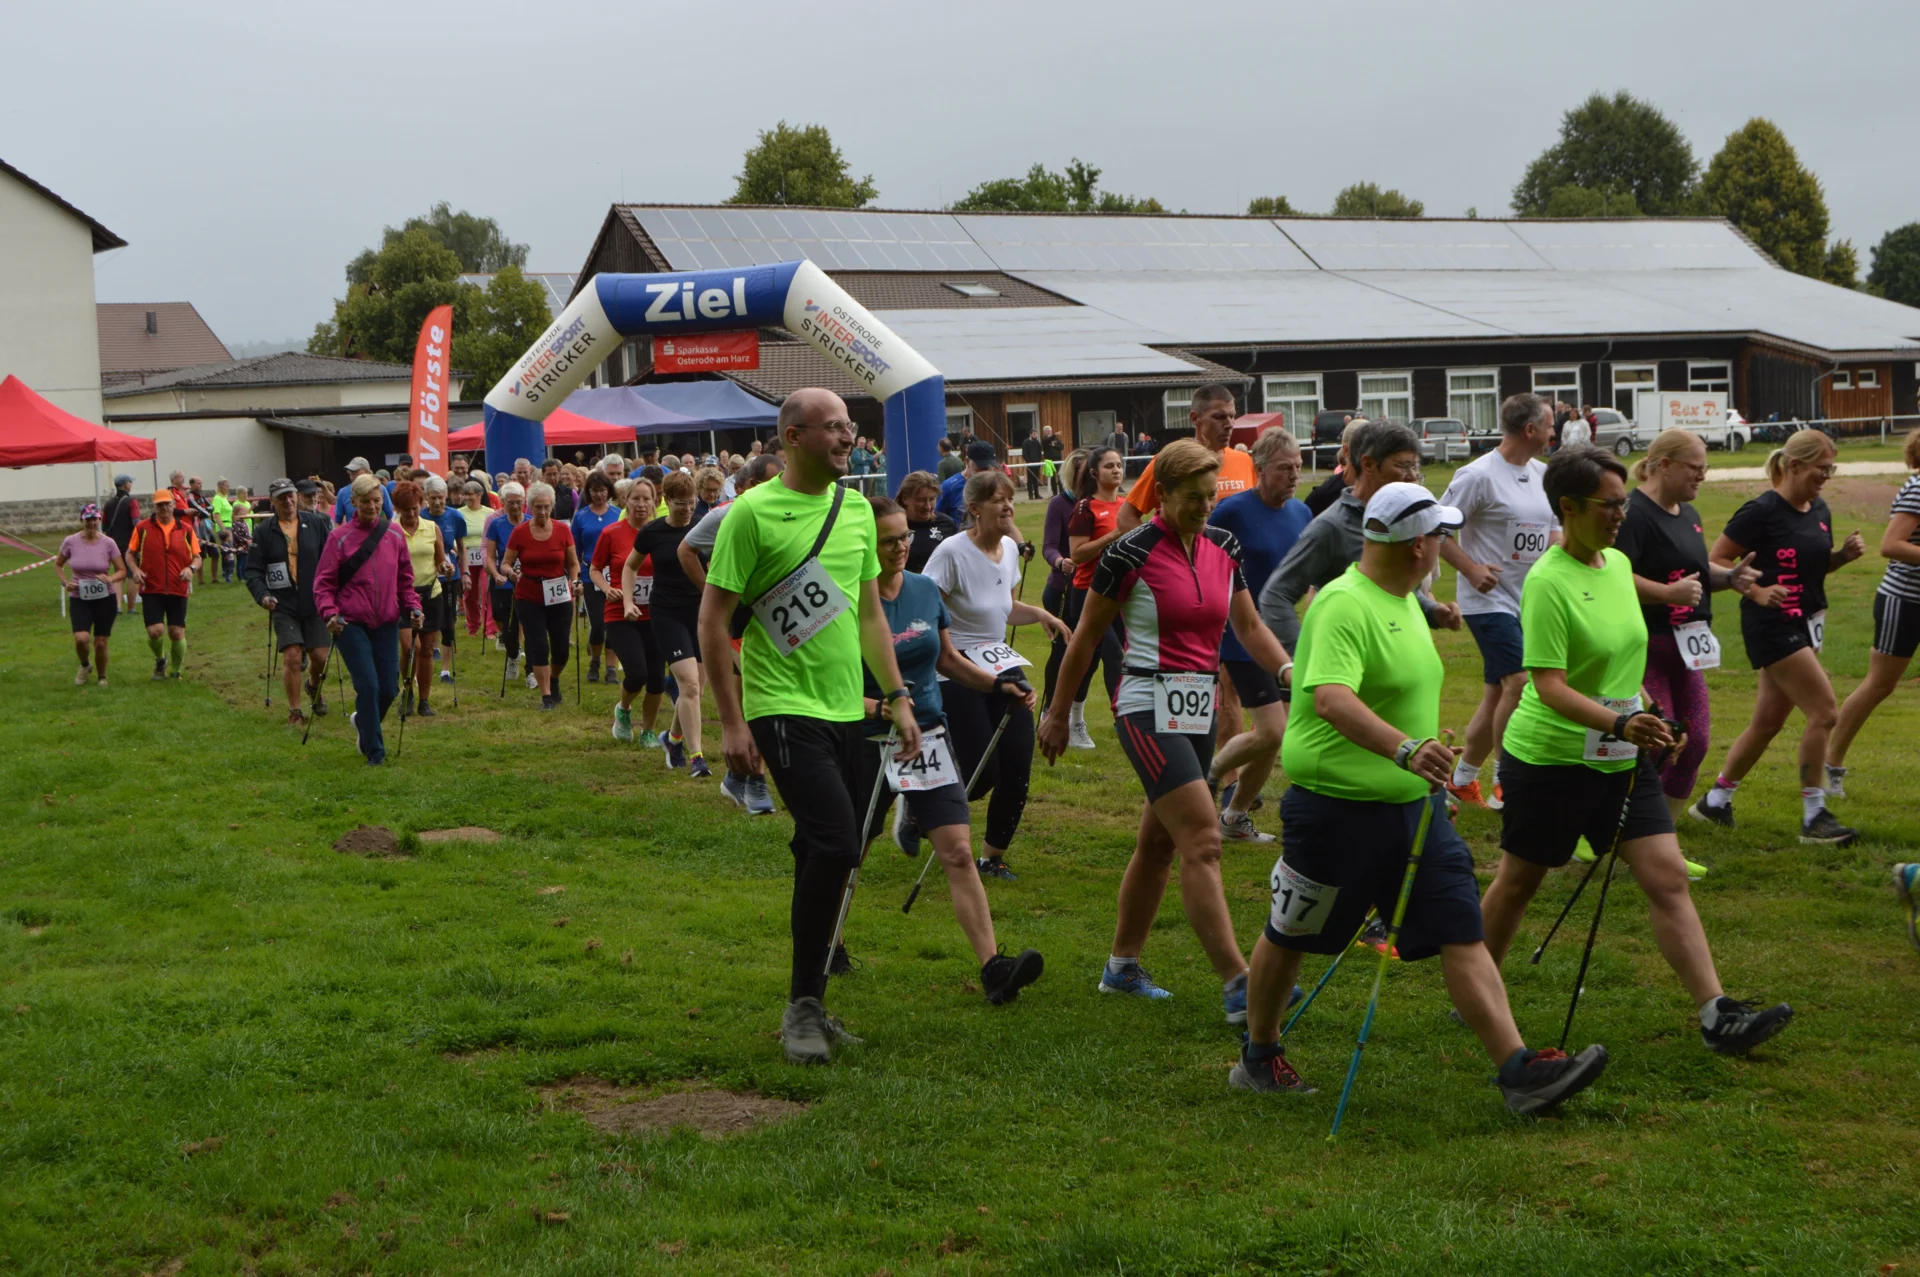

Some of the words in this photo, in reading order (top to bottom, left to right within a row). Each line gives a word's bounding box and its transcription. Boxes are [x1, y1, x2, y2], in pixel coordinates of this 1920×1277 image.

[644, 277, 748, 322] Ziel
[520, 323, 563, 369] OSTERODE
[816, 309, 890, 374] INTERSPORT
[833, 306, 883, 349] OSTERODE
[520, 315, 585, 386] INTERSPORT
[526, 332, 597, 402] STRICKER
[677, 345, 719, 356] Sparkasse
[677, 356, 715, 365] Osterode
[730, 354, 750, 363] Harz
[801, 318, 876, 385] STRICKER
[420, 324, 444, 433] Förste
[1514, 532, 1545, 552] 090
[84, 584, 104, 594] 106
[549, 583, 568, 597] 154
[765, 567, 809, 603] INTERSPORT
[772, 581, 829, 635] 218
[800, 605, 840, 638] Sparkasse
[1168, 690, 1210, 717] 092
